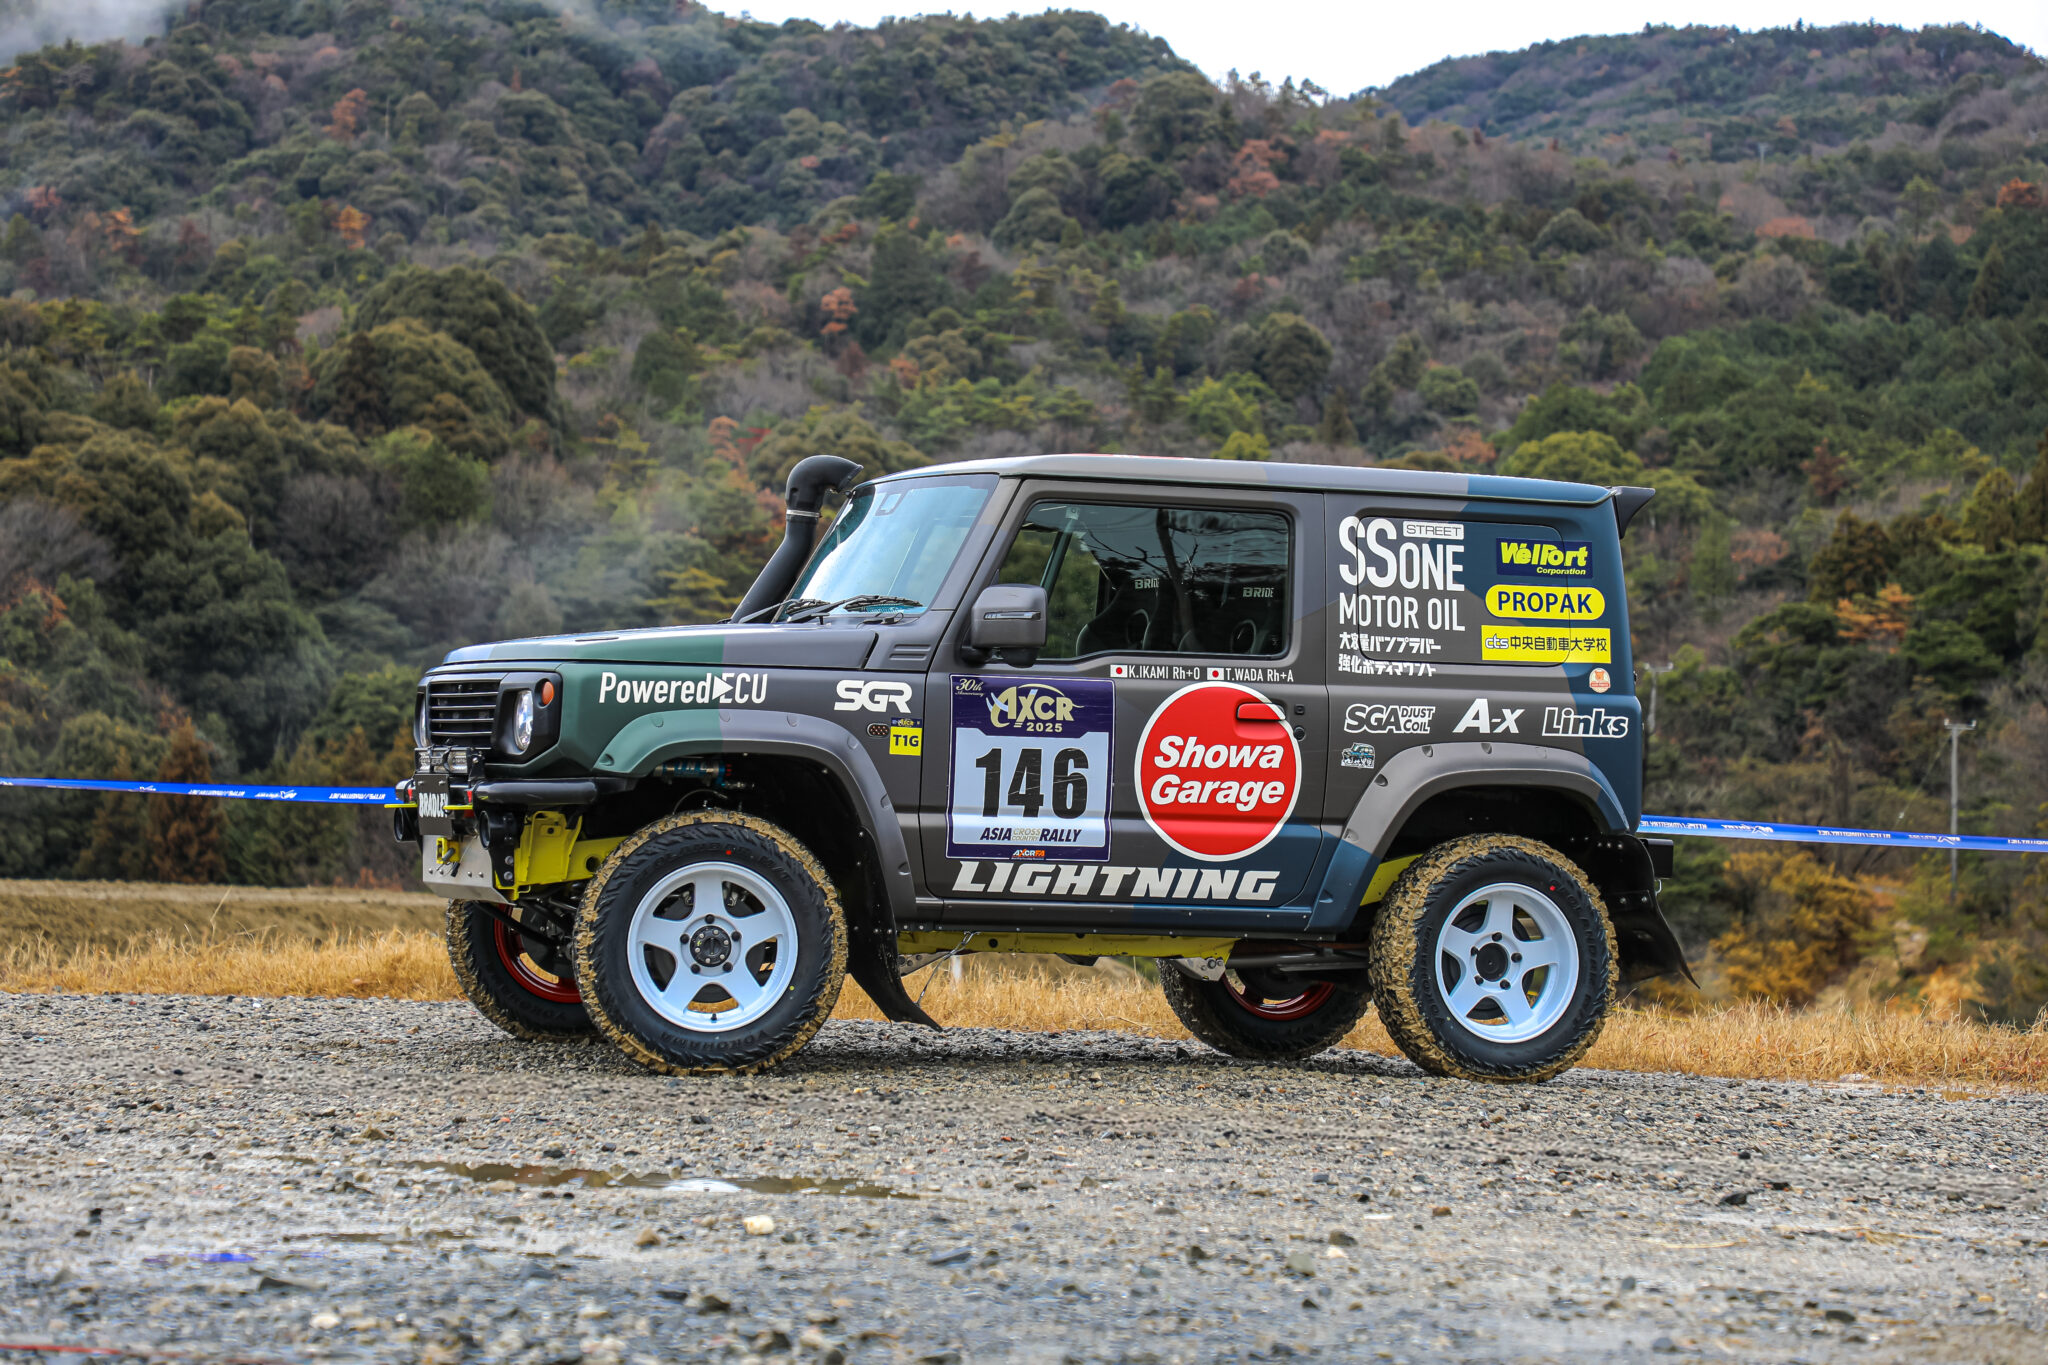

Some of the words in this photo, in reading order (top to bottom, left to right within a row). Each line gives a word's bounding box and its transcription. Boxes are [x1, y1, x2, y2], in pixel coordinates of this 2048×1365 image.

[1406, 524, 1461, 536] STREET
[1537, 567, 1586, 576] Corporation
[1243, 587, 1274, 598] BRIDE
[1498, 591, 1592, 613] PROPAK
[1339, 592, 1419, 628] MOTOR
[1427, 598, 1465, 631] OIL
[1510, 635, 1607, 652] 中央自動車大学校
[1129, 665, 1169, 680] K.IKAMI
[1226, 667, 1264, 682] T.WADA
[1267, 669, 1294, 682] Rh+A
[599, 672, 712, 703] Powered
[956, 678, 984, 691] 30th
[834, 680, 912, 713] SGR
[990, 687, 1075, 728] AXCR
[1026, 722, 1063, 732] 2025
[1542, 707, 1629, 738] Links
[893, 735, 919, 747] T1G
[1154, 735, 1284, 769] Showa
[975, 748, 1089, 819] 146
[1150, 774, 1285, 812] Garage
[980, 827, 1012, 840] ASIA
[1012, 828, 1041, 836] CROSS
[1039, 828, 1082, 842] RALLY
[952, 861, 1280, 900] LIGHTNING
